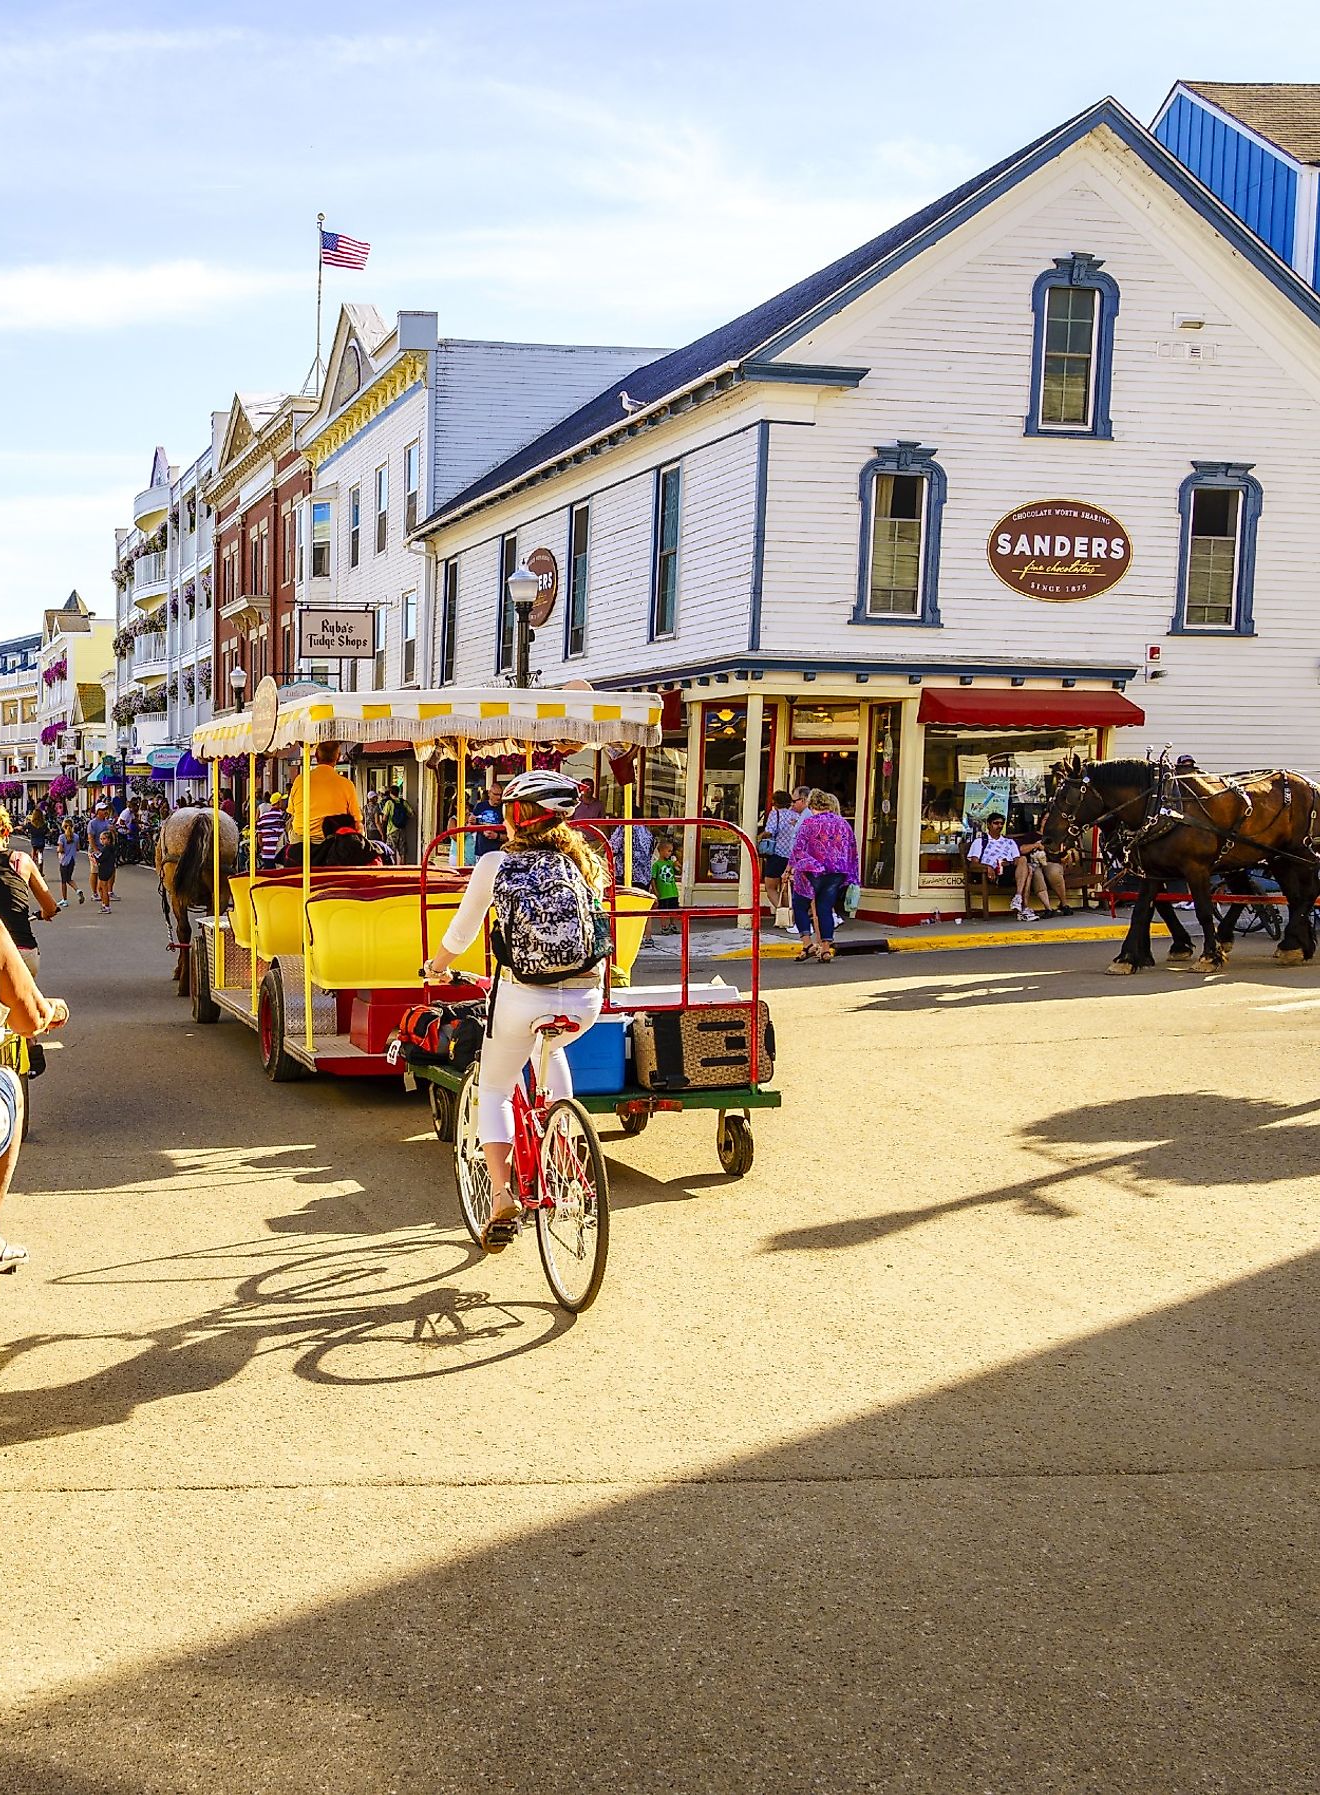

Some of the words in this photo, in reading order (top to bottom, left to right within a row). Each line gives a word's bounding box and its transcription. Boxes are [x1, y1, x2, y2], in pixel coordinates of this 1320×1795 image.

[1012, 508, 1053, 522] CHOCOLATE
[1055, 508, 1079, 518] WORTH
[1081, 511, 1111, 525] SHARING
[996, 532, 1126, 560] SANDERS
[1030, 581, 1061, 593] SINCE
[321, 618, 354, 637] Ryba's
[338, 634, 368, 650] Shops
